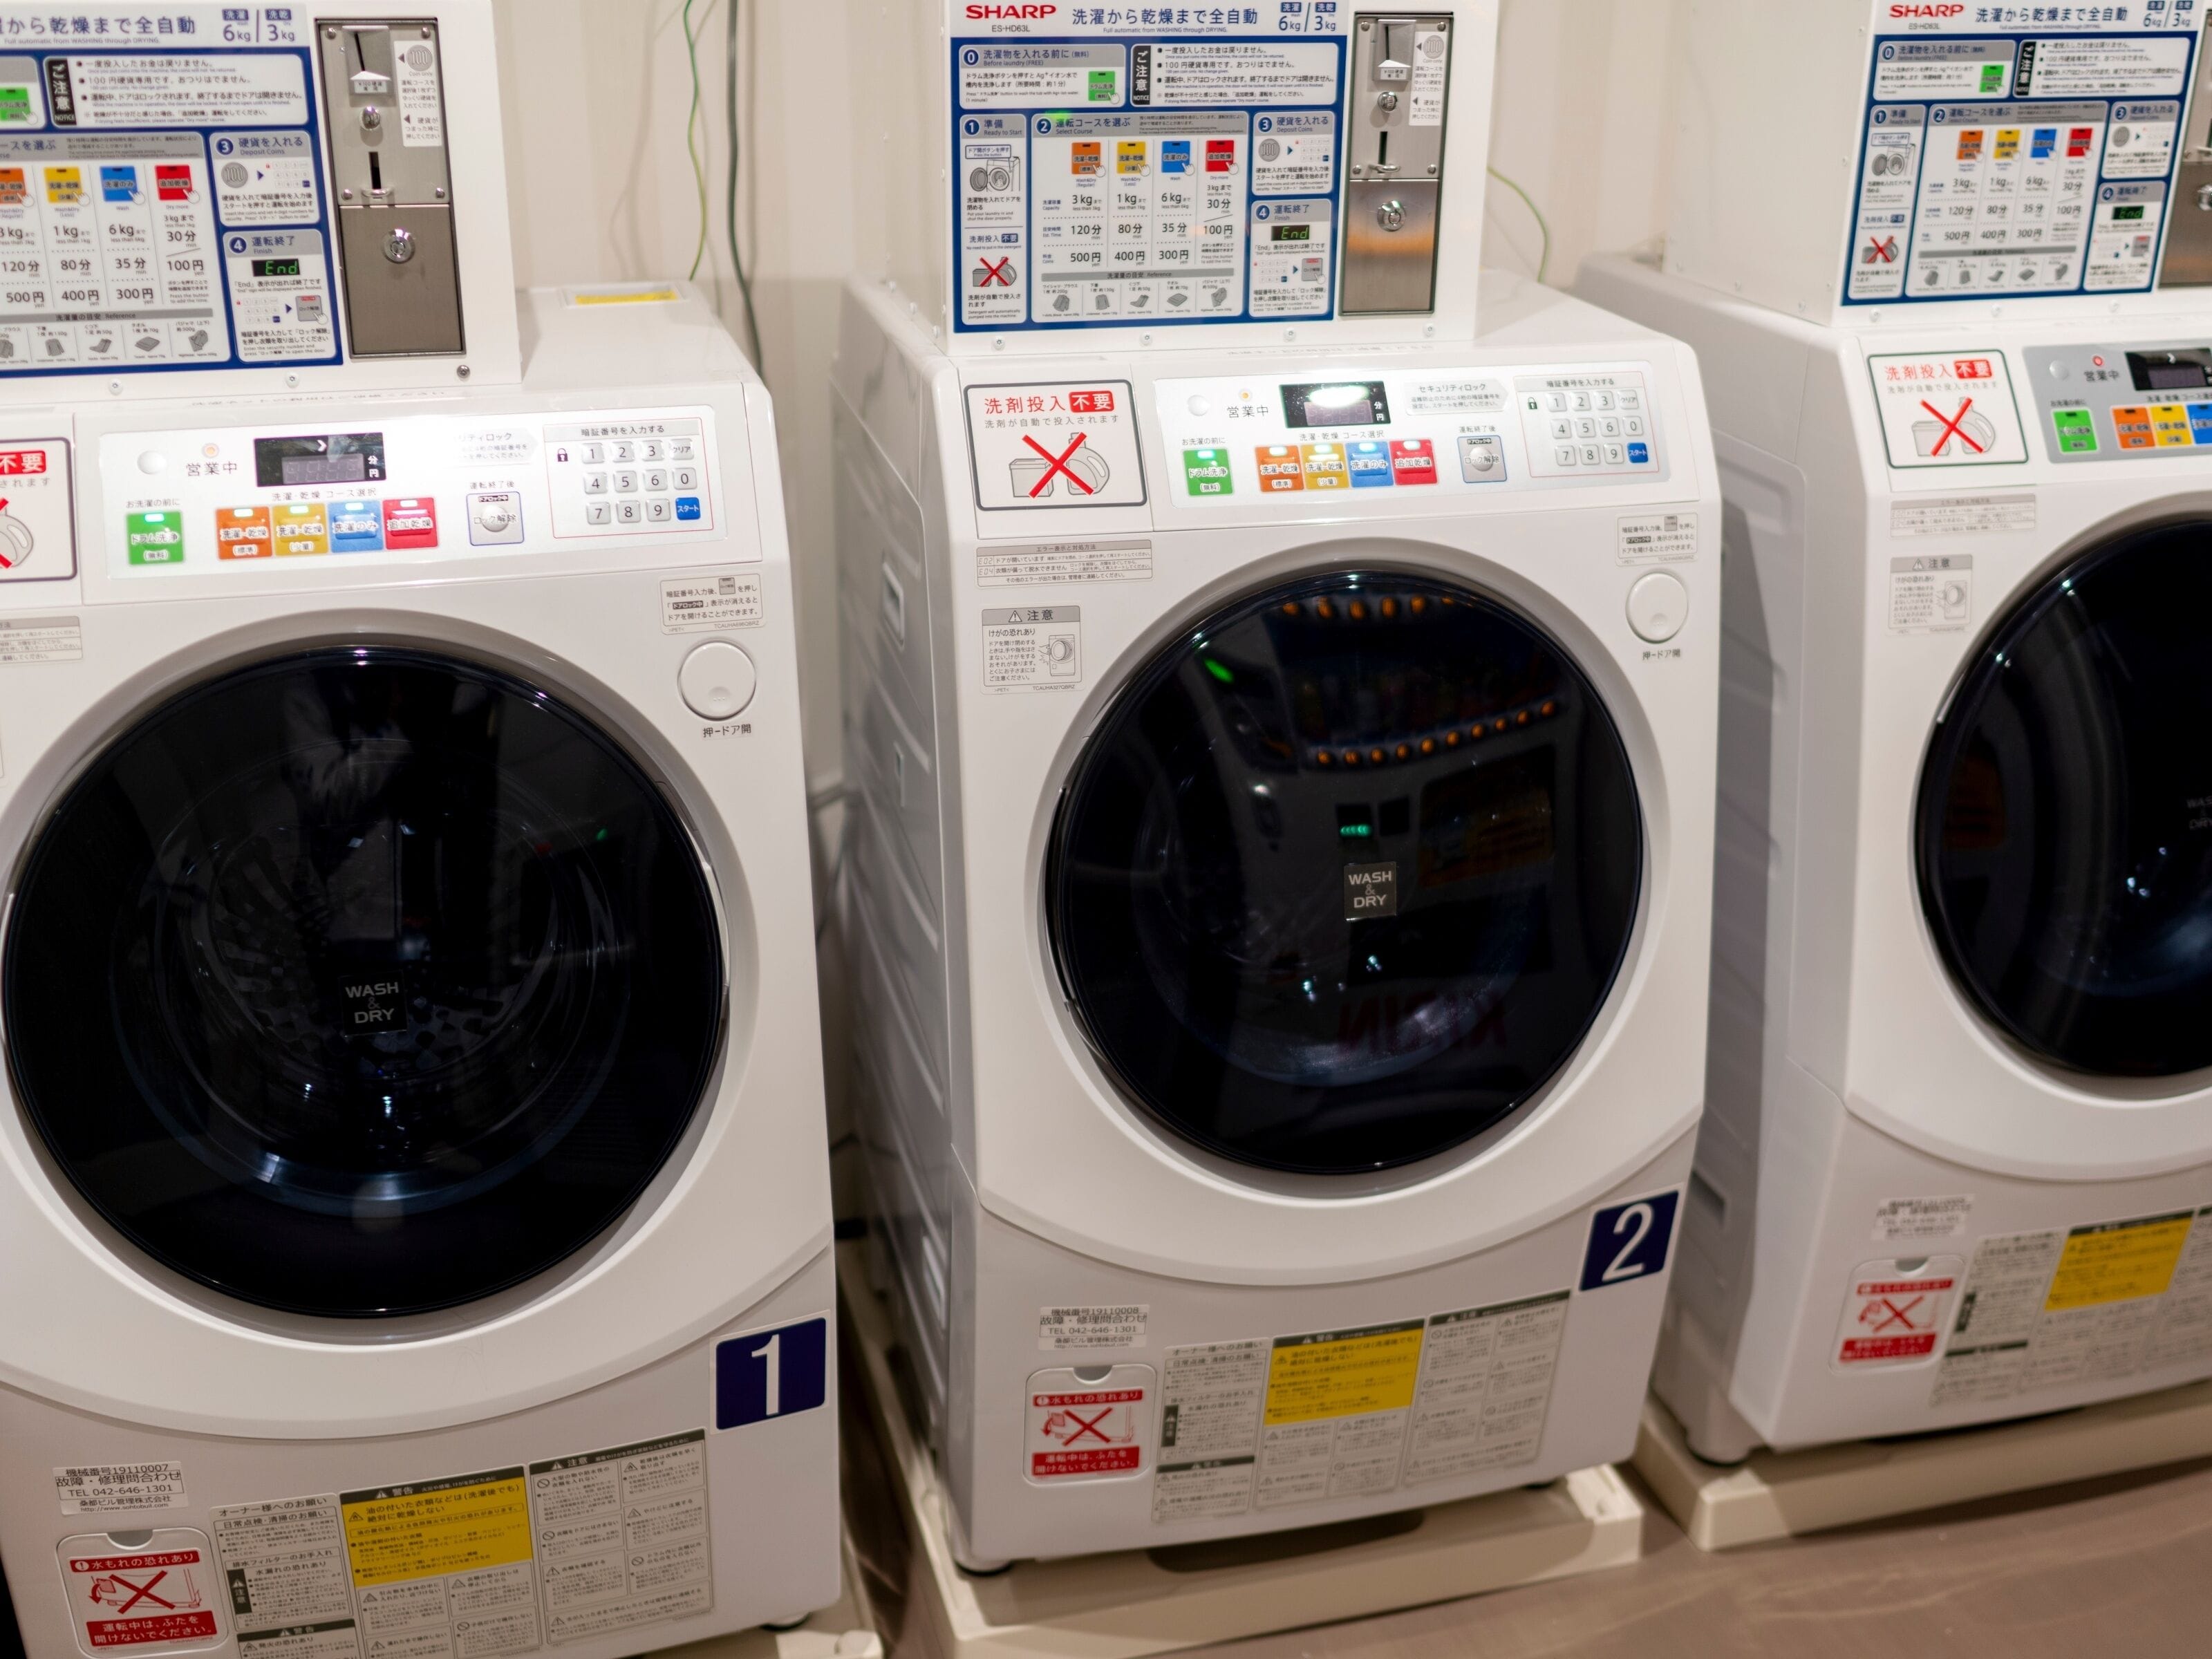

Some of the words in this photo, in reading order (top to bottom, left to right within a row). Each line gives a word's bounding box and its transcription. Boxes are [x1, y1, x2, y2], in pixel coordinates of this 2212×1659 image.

[966, 5, 1056, 19] SHARP
[1282, 3, 1300, 12] 洗濯
[1317, 3, 1334, 12] 洗乾
[1889, 3, 1964, 19] SHARP
[223, 10, 247, 20] 洗濯
[267, 10, 290, 20] 洗乾
[1072, 8, 1257, 26] 洗濯から乾燥まで全自動
[1975, 6, 2128, 24] 洗濯から乾燥まで全自動
[968, 53, 975, 63] 0
[984, 50, 1069, 59] 洗濯物を入れる前に
[1135, 50, 1147, 91] ご注意
[53, 64, 71, 111] ご注意
[984, 120, 1003, 129] 準備
[1040, 121, 1047, 131] 2
[1056, 118, 1130, 128] 運転コースを選ぶ
[1261, 119, 1268, 129] 3
[1277, 117, 1328, 126] 硬貨を入れる
[969, 122, 975, 133] 1
[220, 141, 229, 152] 3
[239, 137, 303, 148] 硬貨を入れる
[1208, 200, 1230, 209] 30分
[1275, 205, 1309, 214] 運転終了
[1259, 208, 1266, 217] 4
[1071, 224, 1101, 235] 120分
[1118, 223, 1142, 234] 80分
[1162, 223, 1186, 232] 35分
[1203, 225, 1232, 234] 100円
[1282, 227, 1308, 239] End
[167, 231, 196, 242] 30分
[252, 236, 294, 246] 運転終了
[1071, 252, 1100, 263] 500円
[1114, 251, 1145, 261] 400円
[1159, 250, 1188, 260] 300円
[2, 261, 39, 272] 120分
[61, 259, 90, 270] 80分
[167, 260, 204, 271] 100円
[265, 261, 298, 275] End
[6, 292, 44, 303] 500円
[62, 290, 99, 301] 400円
[116, 288, 153, 300] 300円
[1884, 363, 1952, 381] 洗剤投入
[1958, 362, 1990, 377] 不要
[2083, 369, 2119, 382] 営業中
[1418, 383, 1486, 393] セキュリティロック
[1547, 378, 1615, 388] 暗証番号を入力する
[984, 395, 1065, 413] 洗剤投入
[1072, 393, 1112, 411] 不要
[1554, 398, 1559, 407] 1
[1577, 397, 1584, 406] 2
[1602, 396, 1608, 406] 3
[1226, 404, 1268, 418] 営業中
[984, 415, 1118, 429] 洗剤が自動で投入されます
[1558, 424, 1565, 433] 4
[1582, 423, 1588, 433] 5
[1606, 422, 1613, 431] 6
[1630, 421, 1637, 431] 0
[581, 424, 665, 437] 暗証番号を入力する
[1343, 430, 1384, 438] コース選択
[1182, 437, 1226, 445] お洗濯の前に
[590, 449, 595, 458] 1
[619, 447, 626, 458] 2
[648, 446, 656, 456] 3
[672, 445, 691, 454] クリア
[1564, 451, 1568, 460] 7
[1586, 450, 1593, 460] 8
[1611, 449, 1618, 458] 9
[1629, 449, 1647, 457] スタート
[368, 456, 378, 465] 分
[1352, 460, 1387, 469] 洗濯のみ
[1396, 457, 1431, 468] 追加乾燥
[1465, 456, 1499, 465] ロック解除
[186, 462, 238, 477] 営業中
[370, 469, 379, 478] 円
[1189, 467, 1227, 478] ドラム洗浄
[470, 480, 515, 490] 運転終了後
[592, 478, 600, 489] 4
[622, 476, 629, 487] 5
[651, 475, 659, 486] 6
[681, 474, 688, 485] 0
[126, 498, 180, 509] お洗濯の前に
[594, 509, 603, 519] 7
[625, 507, 632, 518] 8
[654, 505, 662, 516] 9
[677, 503, 700, 514] スタート
[388, 516, 431, 532] 追加乾燥
[474, 514, 517, 525] ロック解除
[332, 522, 378, 533] 洗濯のみ
[131, 532, 179, 545] ドラム洗浄
[1037, 544, 1096, 552] エラー表示と対処方法
[995, 556, 1044, 564] ドアが開いています
[1929, 558, 1950, 568] 注意
[1027, 610, 1053, 621] 注意
[988, 628, 1035, 637] けがの恐れあり
[1349, 870, 1391, 885] WASH
[1365, 884, 1375, 895] &
[1353, 894, 1387, 908] DRY
[345, 982, 399, 998] WASH
[368, 997, 380, 1009] &
[354, 1009, 394, 1023] DRY
[1602, 1203, 1653, 1282] 2
[1069, 1326, 1136, 1334] 042-646-1301
[751, 1334, 779, 1416] 1
[568, 1457, 588, 1468] 注意
[66, 1464, 168, 1477] 機械番号19110007
[68, 1489, 89, 1497] TEL
[93, 1484, 172, 1496] 042-646-1301
[219, 1497, 328, 1517] オーナー様へのお願い
[92, 1553, 194, 1570] 水もれの恐れあり
[95, 1627, 212, 1644] 開けないでください。
